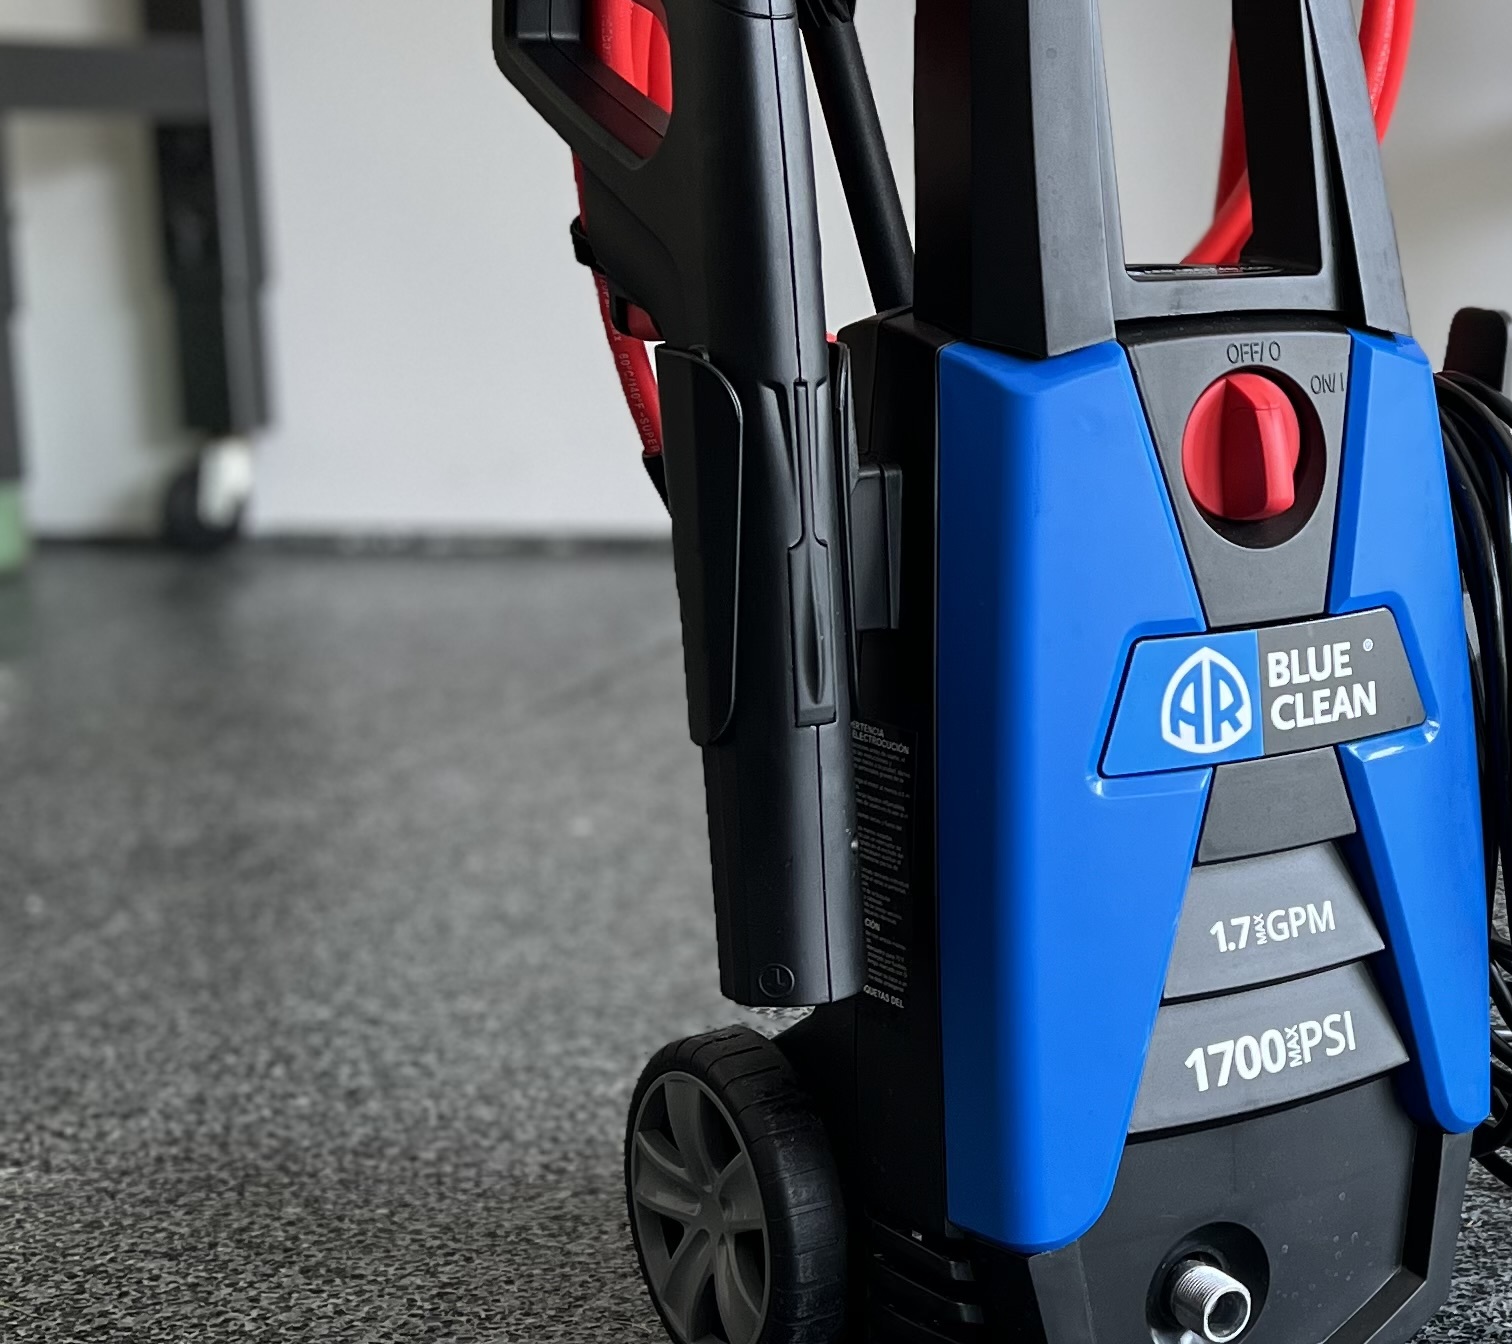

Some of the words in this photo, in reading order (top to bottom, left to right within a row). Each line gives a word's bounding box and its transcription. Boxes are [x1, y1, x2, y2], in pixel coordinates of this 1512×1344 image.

[1267, 641, 1353, 688] BLUE
[1166, 653, 1248, 748] AR
[1270, 680, 1378, 731] CLEAN
[850, 720, 885, 738] ERTENCIA
[1209, 915, 1251, 953] 1.7
[1253, 913, 1268, 945] MAX
[1266, 900, 1336, 942] GPM
[863, 984, 890, 1003] QUETAS
[1184, 1029, 1288, 1092] 1700
[1284, 1024, 1303, 1068] MAX
[1298, 1010, 1357, 1064] PSI
